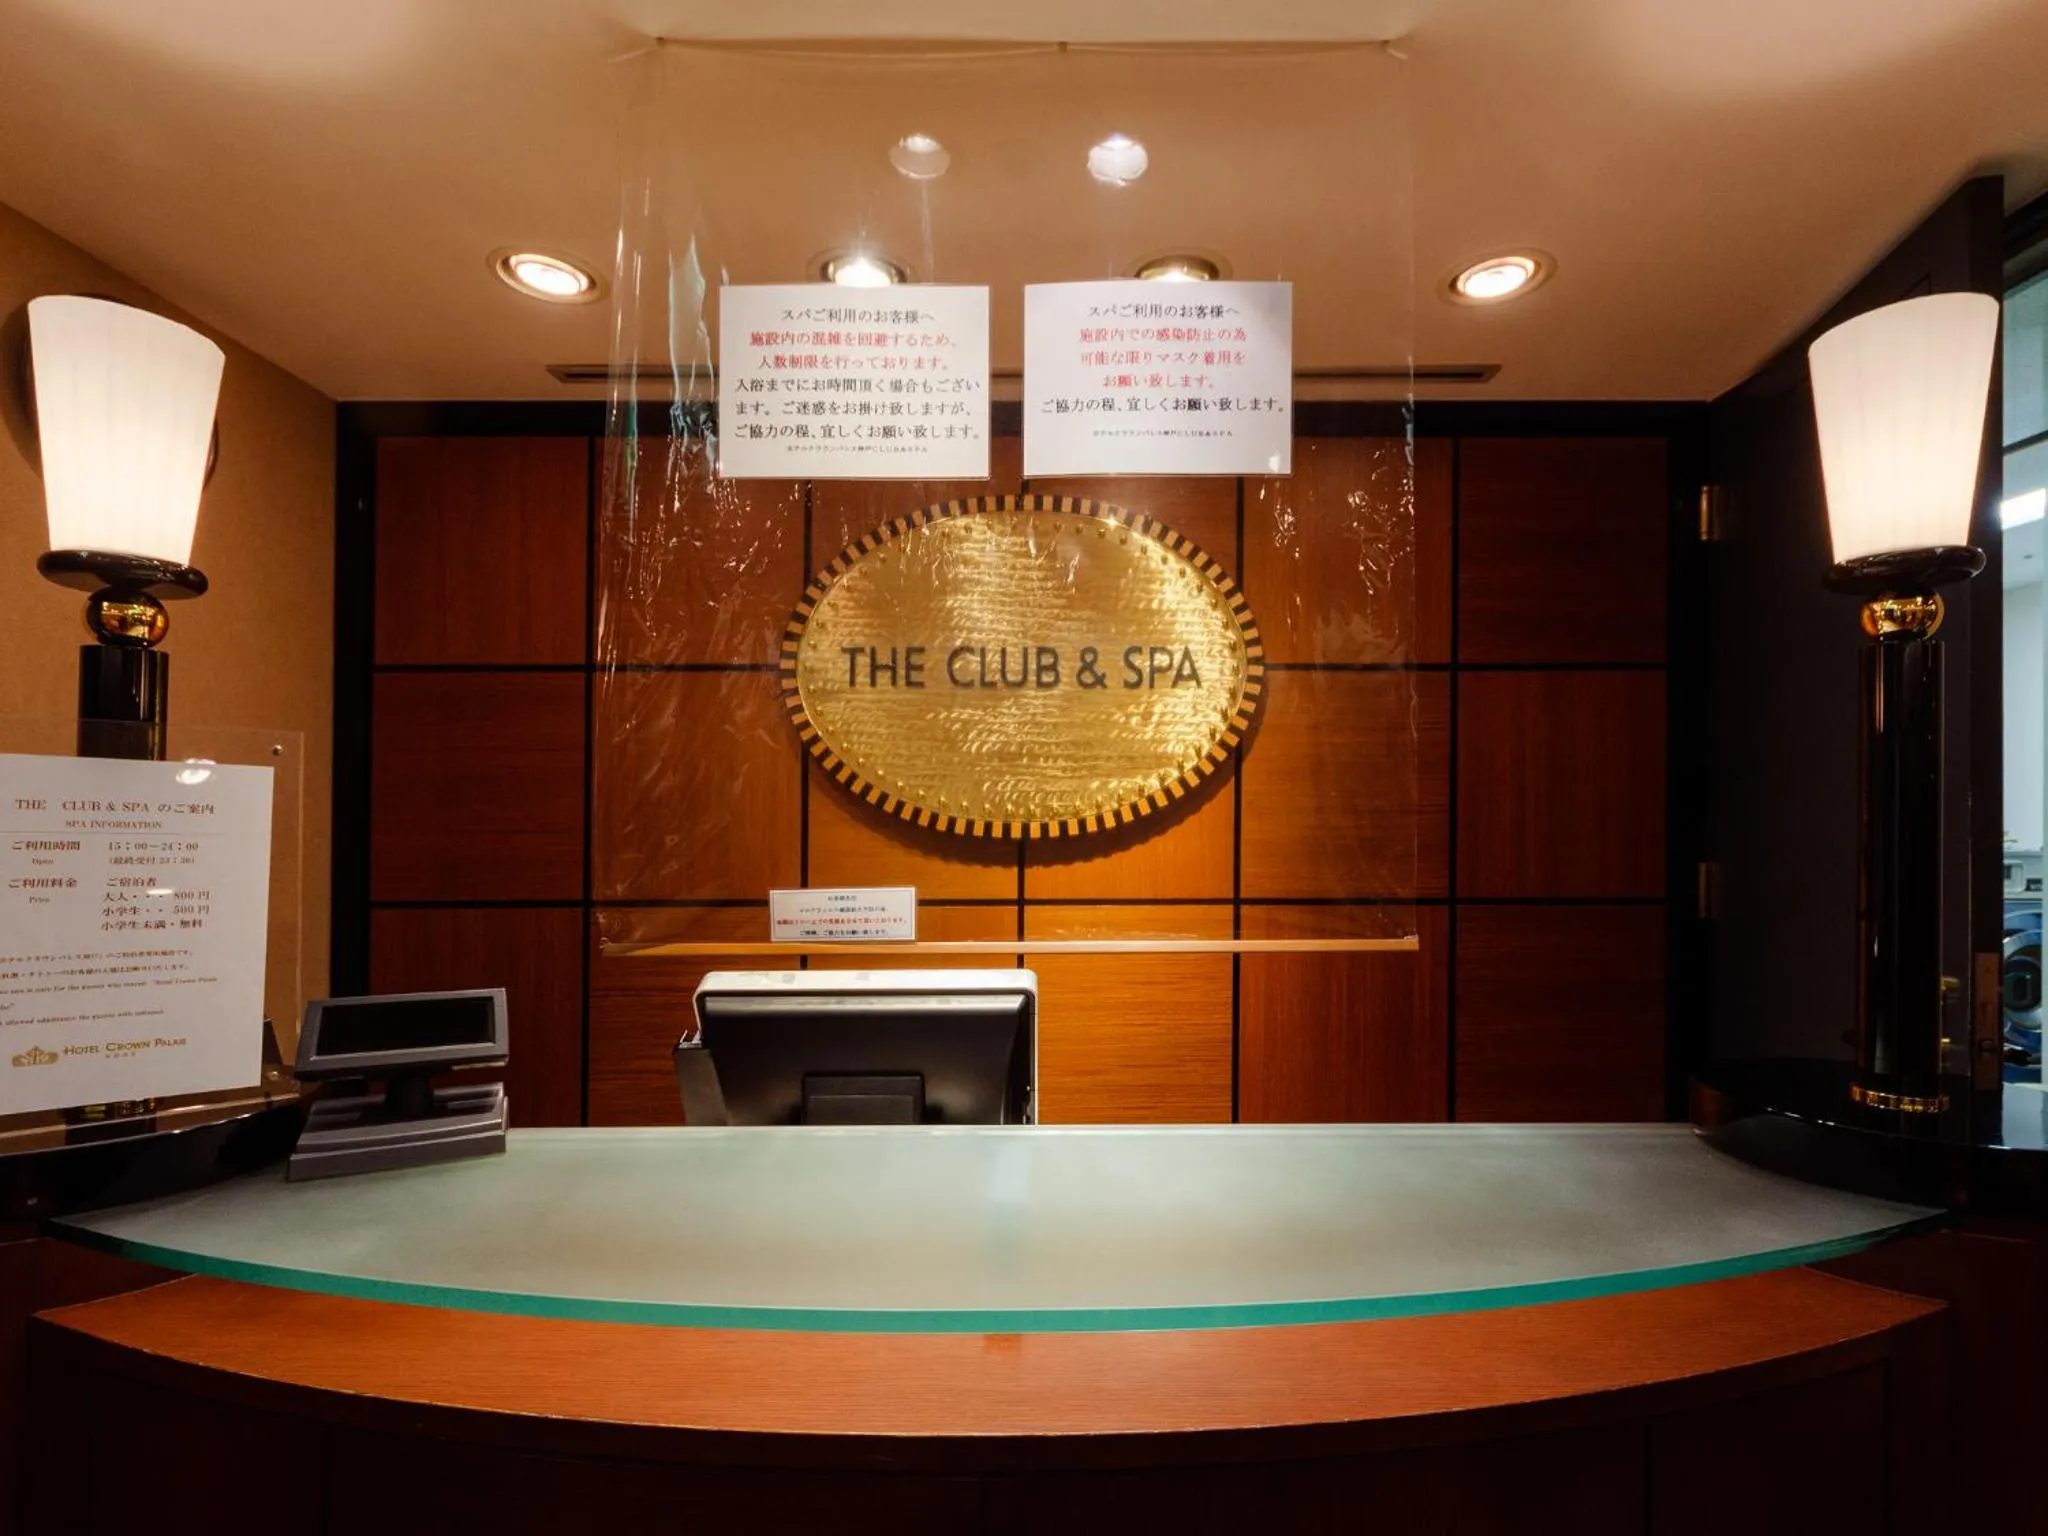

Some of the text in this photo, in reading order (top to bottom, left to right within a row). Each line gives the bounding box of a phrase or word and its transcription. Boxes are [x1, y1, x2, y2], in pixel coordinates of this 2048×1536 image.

[782, 308, 936, 324] スパご利用のお客様へ
[1089, 304, 1240, 319] スパご利用のお客様へ
[750, 331, 958, 347] 施設内の混雑を回避するため、
[1079, 328, 1247, 343] 施設内での感染防止の為
[759, 354, 949, 370] 人数制限を行っております。
[1081, 350, 1246, 366] 可能な限りマスク着用を
[735, 378, 981, 393] 入浴までにお時間頂く場合もござい
[1102, 374, 1216, 389] お願い致します。
[735, 401, 972, 417] ます。ご迷惑をお掛け致しますが、
[1041, 397, 1285, 414] ご協力の程、宜しくお願い致します。
[734, 424, 980, 439] ご協力の程、宜しくお願い致します。
[841, 645, 1202, 689] THE CLUB & SPA
[15, 799, 215, 815] THE CLUB & SPA のご案内
[65, 820, 162, 829] SPA INFORMATION
[12, 840, 81, 850] ご利用時間
[8, 877, 157, 888] ご利用料金 ご宿泊者
[63, 1044, 100, 1056] HOTEL
[105, 1040, 150, 1052] CROWN
